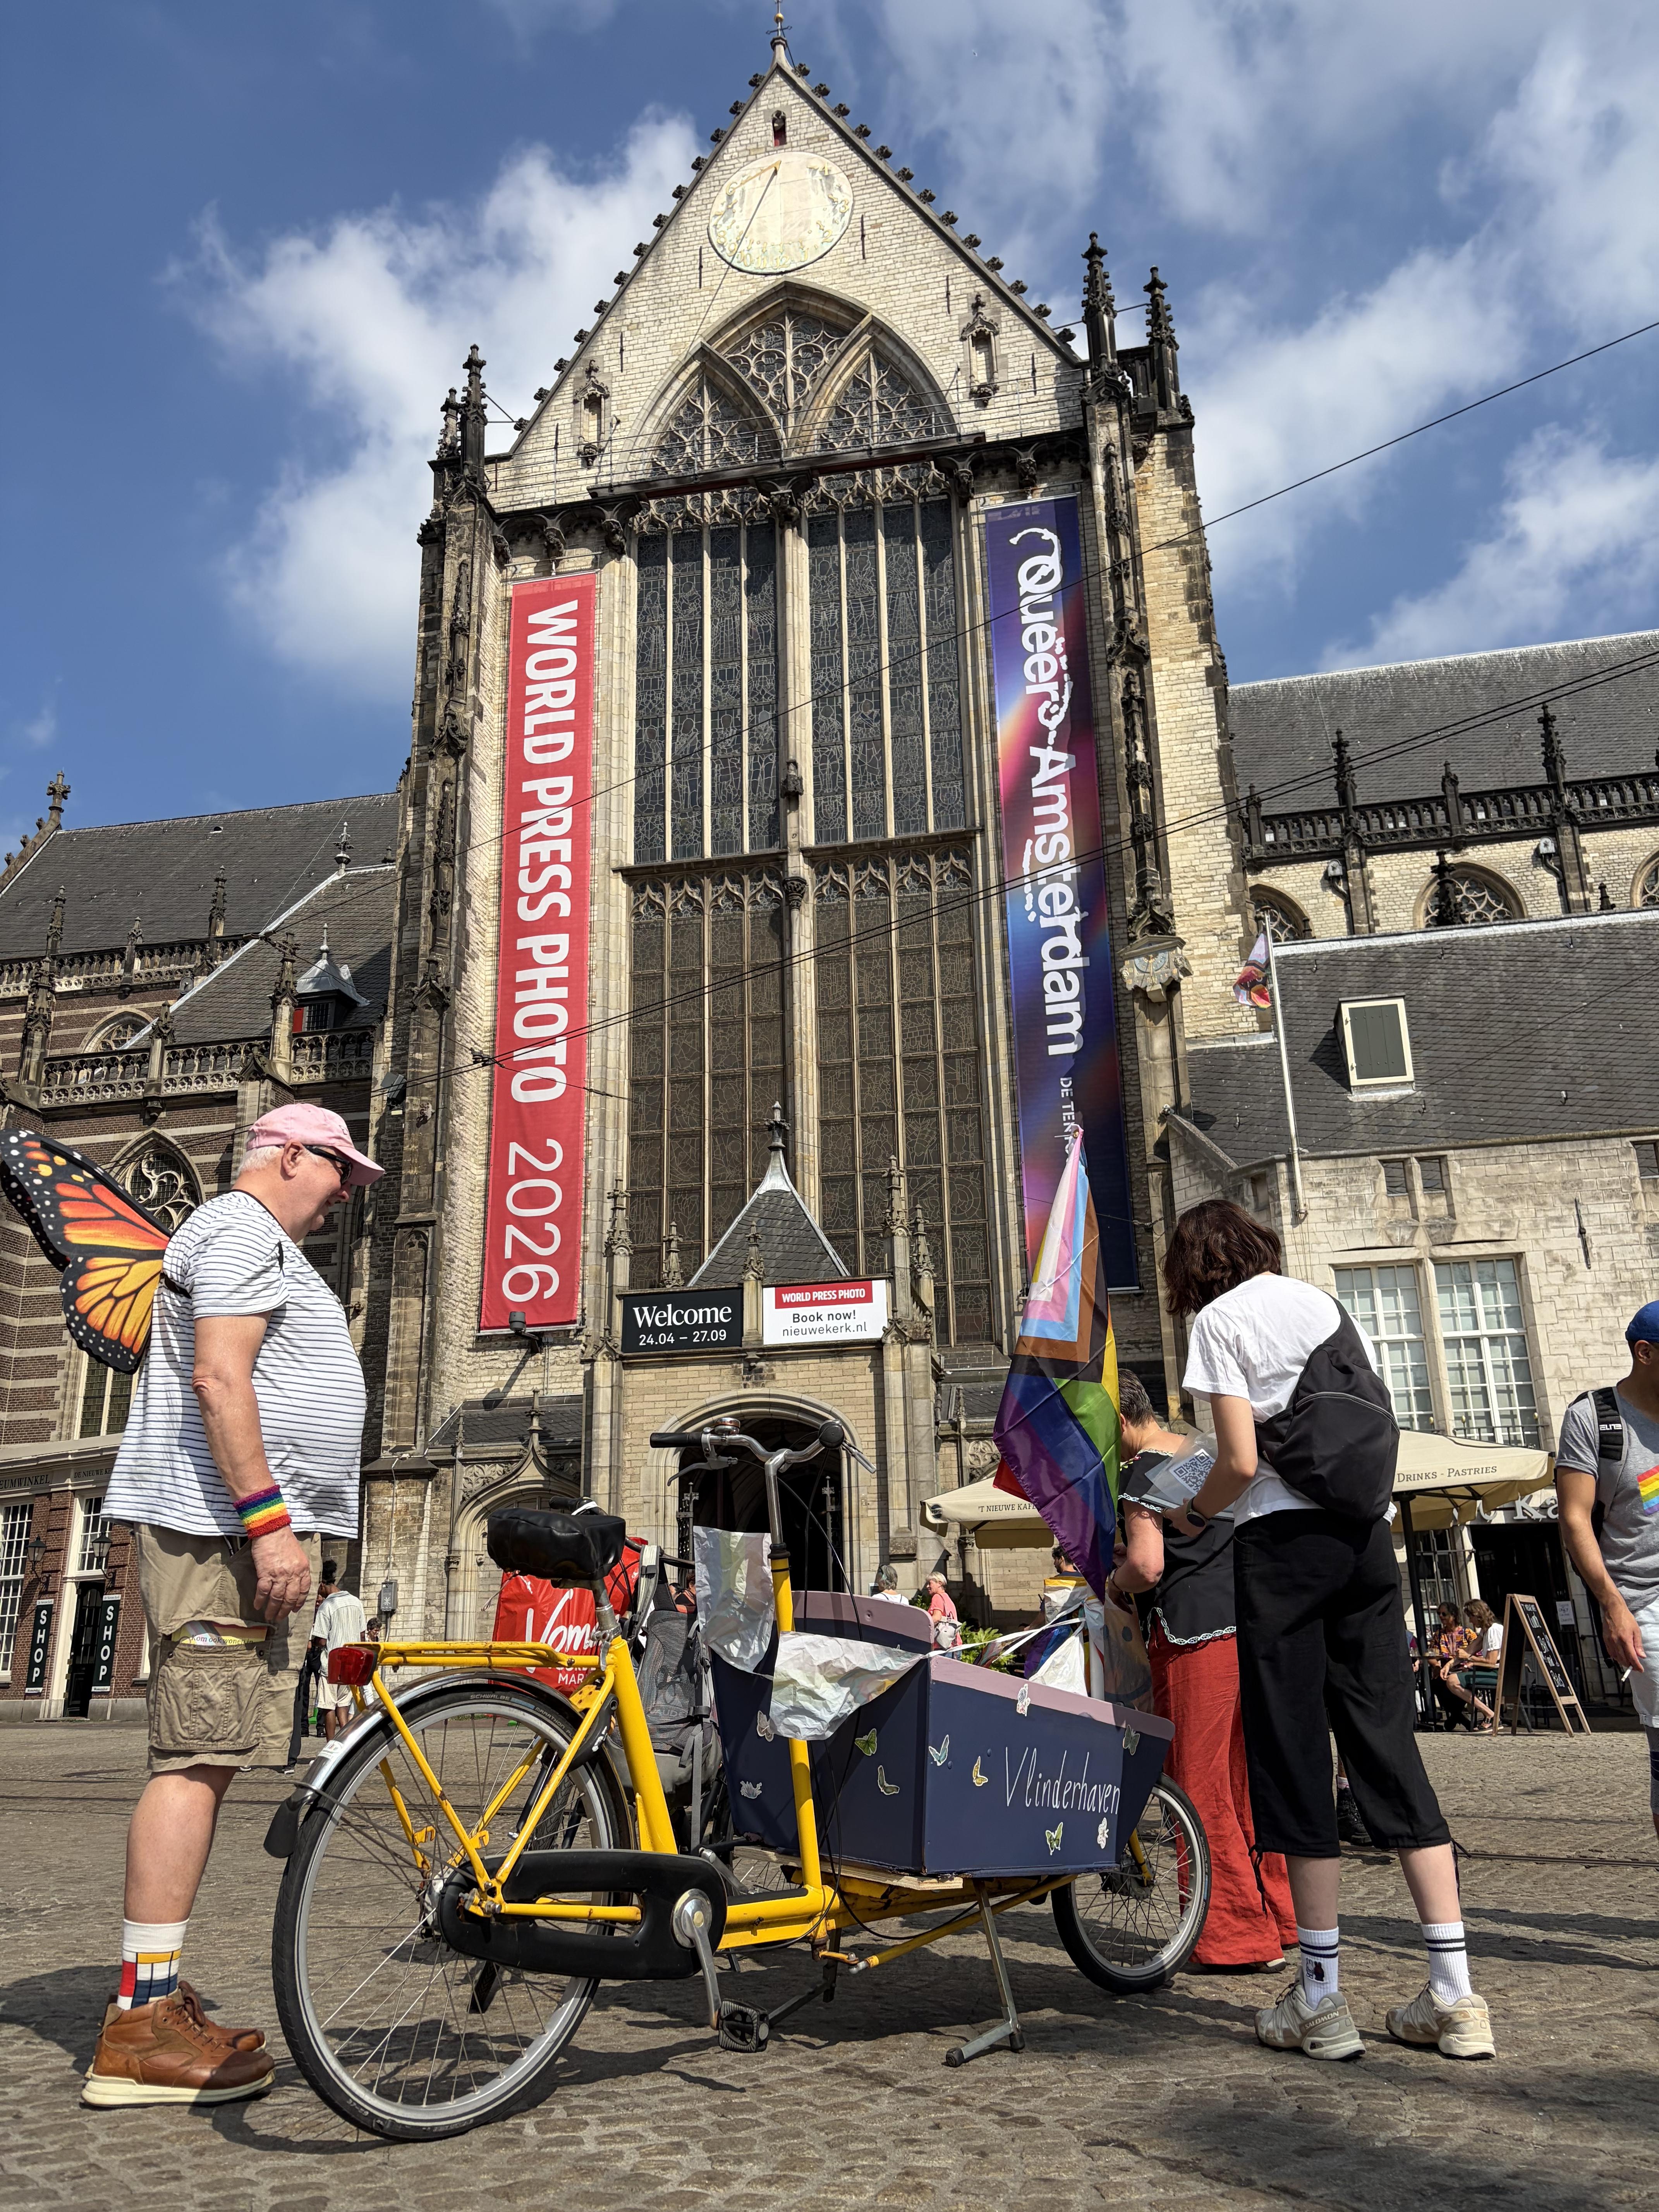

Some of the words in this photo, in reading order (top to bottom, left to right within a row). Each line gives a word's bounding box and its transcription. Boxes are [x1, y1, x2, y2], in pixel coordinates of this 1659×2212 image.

[839, 198, 849, 213] 3
[717, 230, 726, 244] 8
[821, 229, 833, 244] 2
[726, 242, 737, 257] 9
[1010, 527, 1073, 729] Queer
[523, 599, 578, 765] WORLD
[517, 776, 574, 922] PRESS
[1030, 744, 1089, 1056] Amsterdam
[511, 934, 570, 1103] PHOTO
[1060, 1077, 1073, 1098] DE
[501, 1138, 564, 1302] 2026
[782, 1292, 811, 1303] WORLD
[812, 1290, 837, 1301] PRESS
[838, 1288, 866, 1299] PHOTO
[632, 1304, 732, 1328] Welcome
[793, 1312, 823, 1323] Book
[828, 1310, 856, 1321] now!
[639, 1333, 675, 1346] 24.04
[692, 1329, 727, 1343] 27.09
[783, 1322, 867, 1336] nieuwekerk.nl
[83, 1469, 103, 1477] NIEUWE
[1397, 1472, 1437, 1482] DRINKS
[1447, 1466, 1497, 1478] PASTRIES
[1513, 1492, 1558, 1520] Ka
[526, 1588, 619, 1673] Vom
[33, 1609, 47, 1683] SHOP
[99, 1606, 114, 1681] SHOP
[558, 1673, 585, 1685] MAR
[535, 1707, 565, 1729] MARATHON
[1006, 1747, 1120, 1815] Vlinderhaven
[1305, 2011, 1339, 2029] SALOMON
